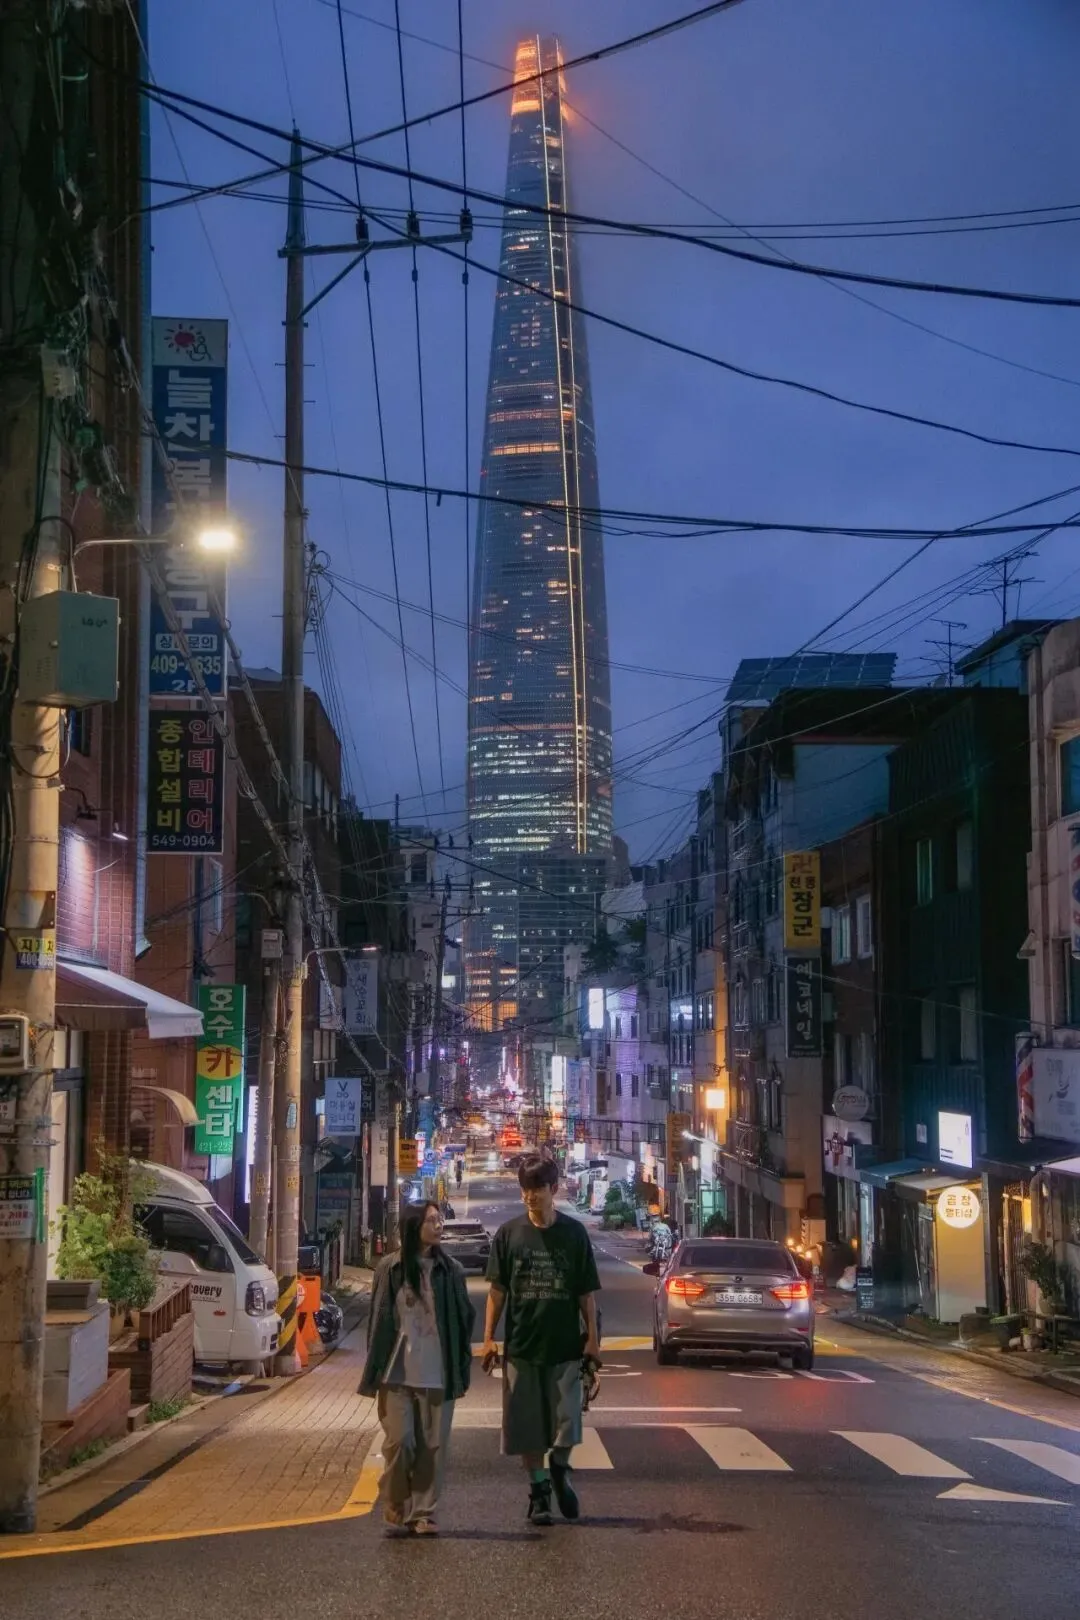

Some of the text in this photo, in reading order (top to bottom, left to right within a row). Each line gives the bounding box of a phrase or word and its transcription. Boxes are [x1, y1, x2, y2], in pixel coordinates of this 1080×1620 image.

[160, 635, 214, 649] 상문의
[151, 655, 221, 675] 409-635
[156, 719, 184, 833] 종합설비
[186, 719, 216, 834] 인테리어
[152, 834, 216, 847] 549-0904
[191, 1285, 222, 1297] overy
